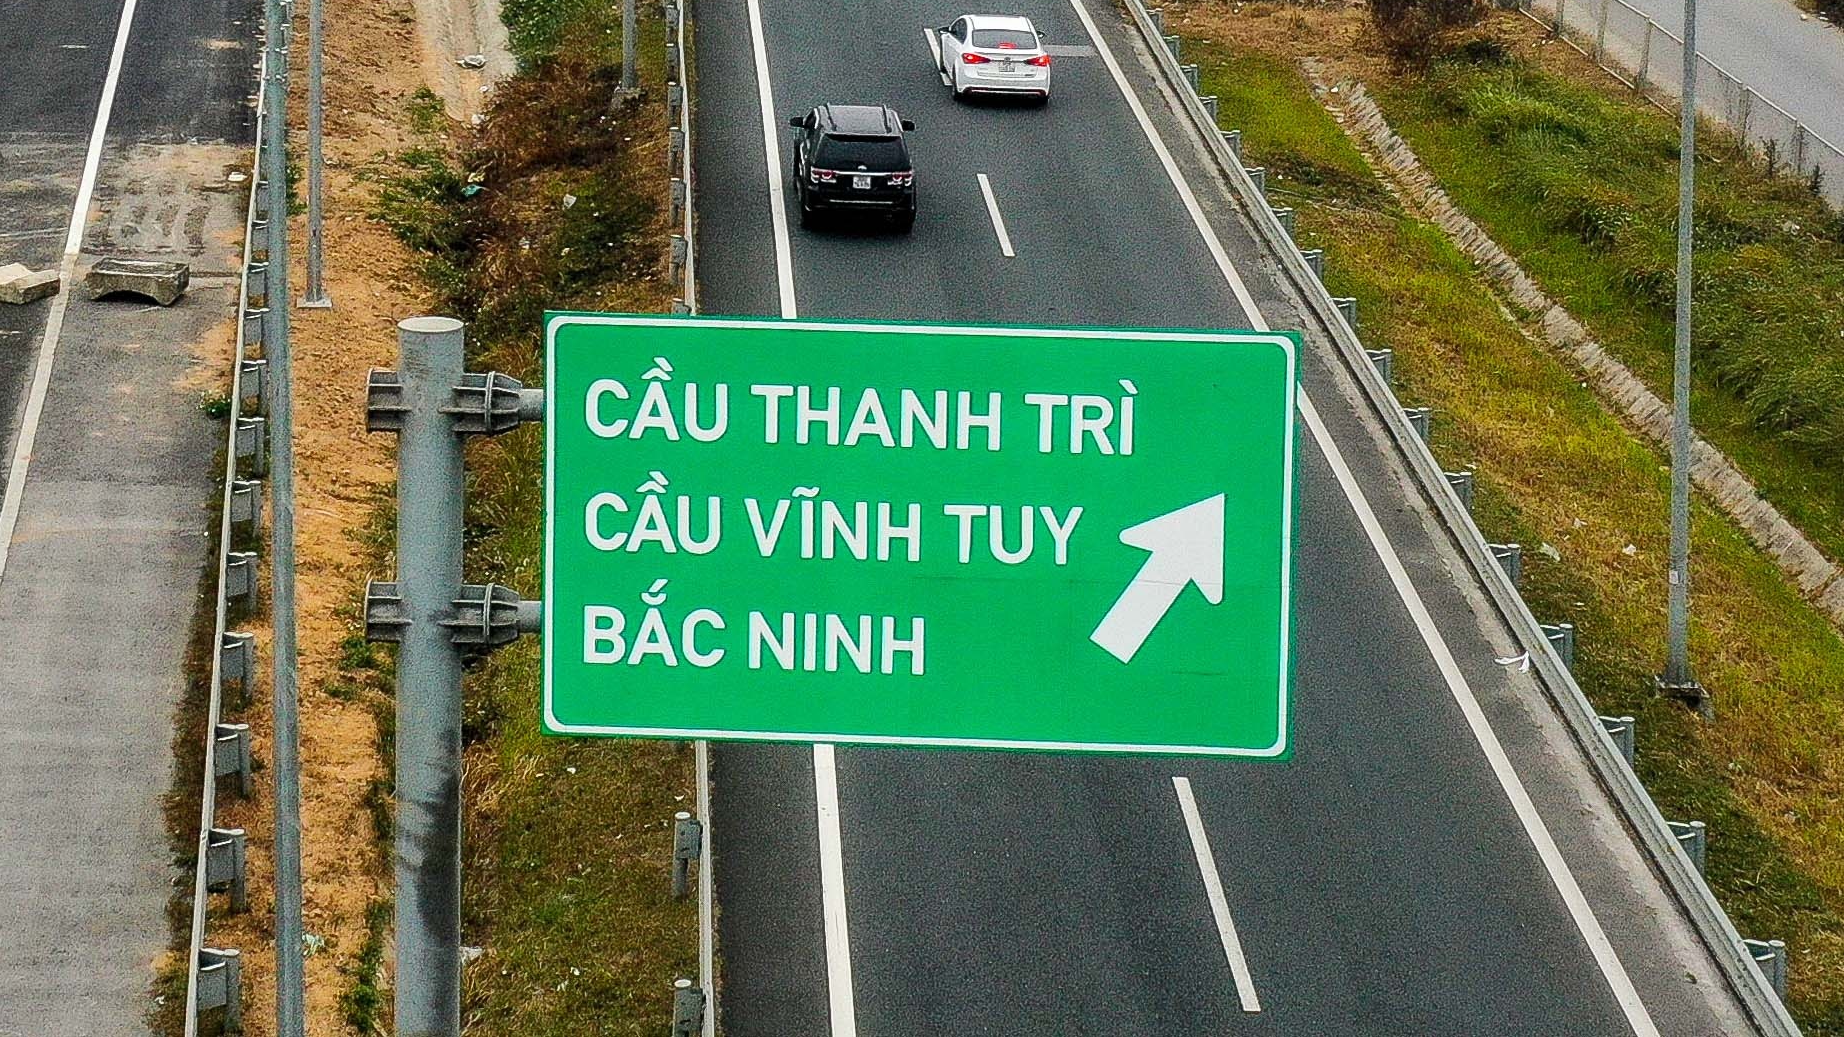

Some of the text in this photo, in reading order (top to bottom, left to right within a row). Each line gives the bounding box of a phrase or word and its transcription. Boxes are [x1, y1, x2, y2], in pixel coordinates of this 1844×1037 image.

[585, 356, 1139, 457] CẦU THANH TRÌ
[585, 470, 1085, 565] CẦU VĨNH TUY
[583, 577, 926, 677] BẮC NINH
